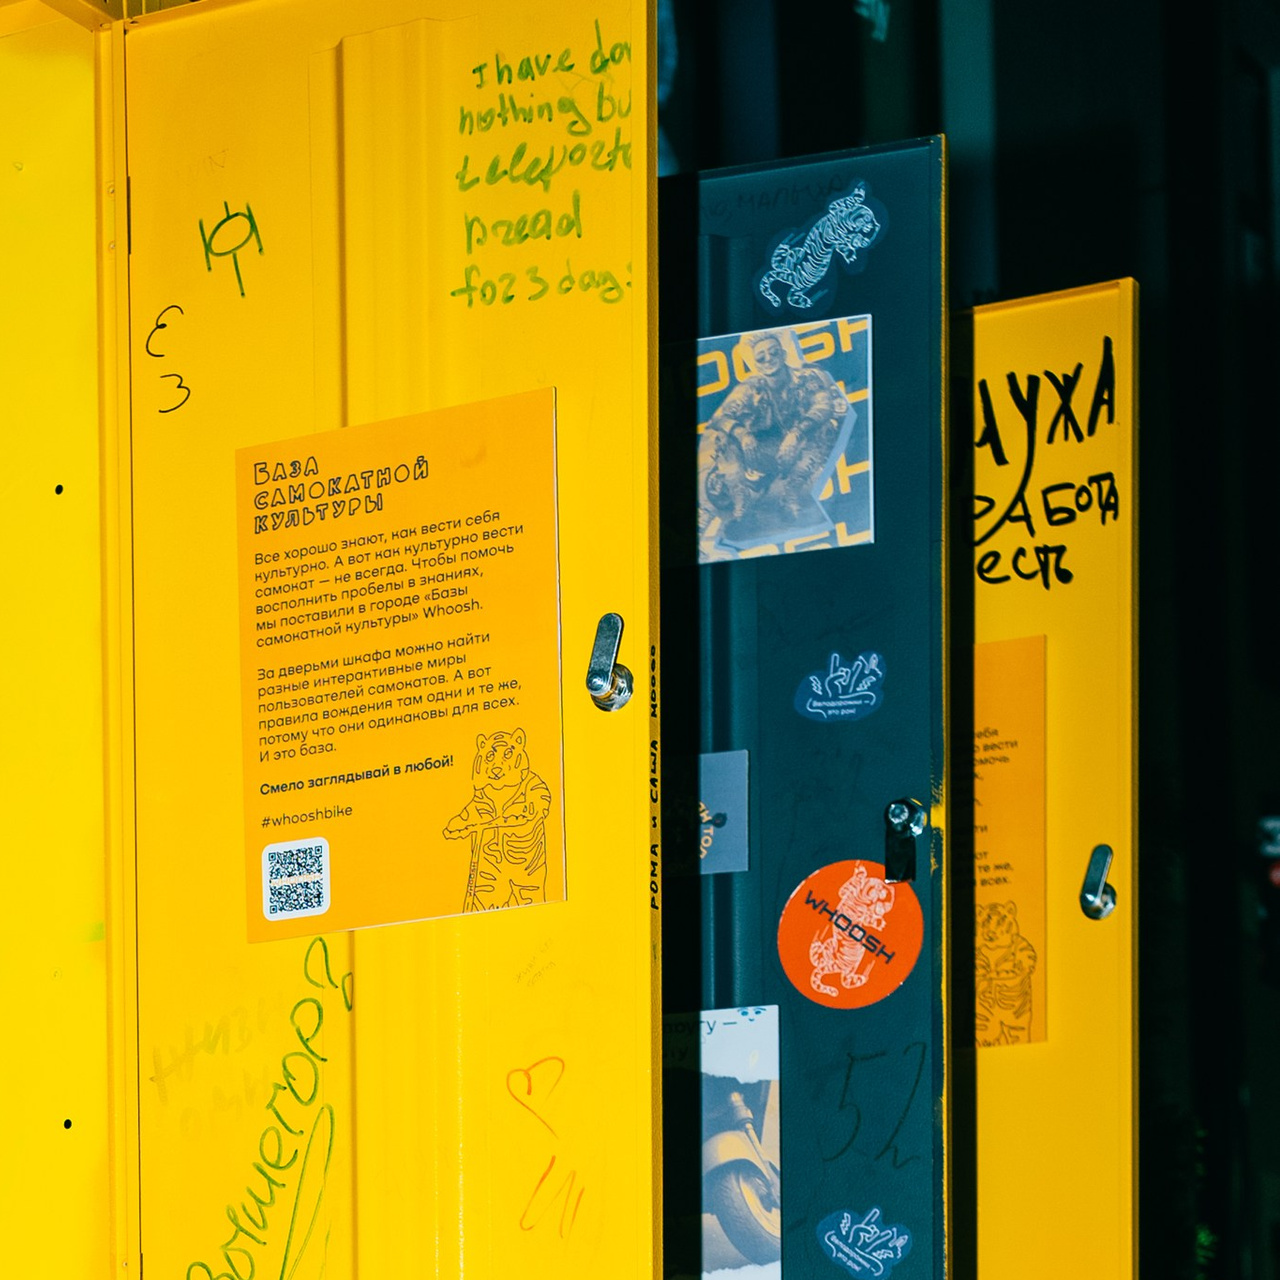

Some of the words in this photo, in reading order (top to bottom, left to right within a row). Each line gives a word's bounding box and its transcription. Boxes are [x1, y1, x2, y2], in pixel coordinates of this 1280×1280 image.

[495, 48, 576, 85] have
[458, 92, 593, 137] nothing
[526, 265, 551, 301] 3
[253, 456, 320, 486] БАЗА
[253, 455, 430, 511] САМОКАТНОЙ
[253, 493, 384, 535] КУЛЬТУРЫ
[254, 552, 280, 565] Все
[283, 541, 337, 560] хорошо
[340, 532, 387, 550] знают,
[391, 527, 417, 540] как
[420, 518, 461, 535] вести
[465, 509, 500, 527] себя
[254, 560, 329, 584] культурно.
[333, 555, 344, 568] А
[347, 552, 371, 565] вот
[375, 547, 400, 560] как
[404, 532, 479, 557] культурно
[482, 524, 523, 541] вести
[254, 579, 315, 598] самокат
[334, 572, 351, 584] не
[355, 563, 407, 581] всегда.
[411, 551, 456, 569] Чтобы
[460, 544, 514, 561] помочь
[976, 545, 1074, 590] есть
[255, 593, 338, 615] восполнить
[341, 580, 404, 601] пробелы
[407, 578, 416, 588] в
[419, 566, 483, 586] знаниях,
[256, 619, 276, 631] мы
[280, 605, 354, 627] поставили
[358, 603, 366, 614] в
[369, 594, 420, 612] городе
[424, 585, 468, 601] «Базы
[256, 621, 341, 648] самокатной
[345, 612, 419, 634] культуры»
[422, 598, 483, 619] Whoosh.
[257, 668, 275, 681] За
[277, 658, 339, 679] дверьми
[342, 649, 391, 666] шкафа
[395, 640, 443, 657] можно
[447, 632, 490, 648] найти
[257, 680, 310, 700] разные
[313, 661, 423, 688] интерактивные
[427, 654, 466, 669] миры
[258, 684, 364, 713] пользователей
[367, 674, 449, 696] самокатов.
[453, 669, 464, 682] А
[467, 666, 491, 679] вот
[258, 711, 318, 731] правила
[322, 699, 393, 720] вождения
[396, 694, 423, 707] там
[426, 688, 462, 703] одни
[466, 686, 475, 696] и
[478, 683, 494, 694] те
[498, 679, 521, 691] же,
[259, 730, 308, 746] потому
[311, 725, 335, 737] что
[338, 721, 364, 734] они
[367, 707, 448, 729] одинаковы
[451, 702, 479, 717] для
[482, 696, 519, 711] всех.
[259, 750, 269, 763] И
[273, 748, 296, 761] это
[299, 742, 336, 756] база.
[983, 740, 1019, 753] вести
[259, 780, 305, 795] Смело
[307, 764, 390, 788] заглядывай
[393, 765, 401, 775] в
[404, 754, 454, 773] любой!
[649, 739, 660, 804] САША
[261, 804, 353, 828] #whooshbike
[649, 843, 660, 911] РОМА
[805, 890, 895, 965] WHOOSH
